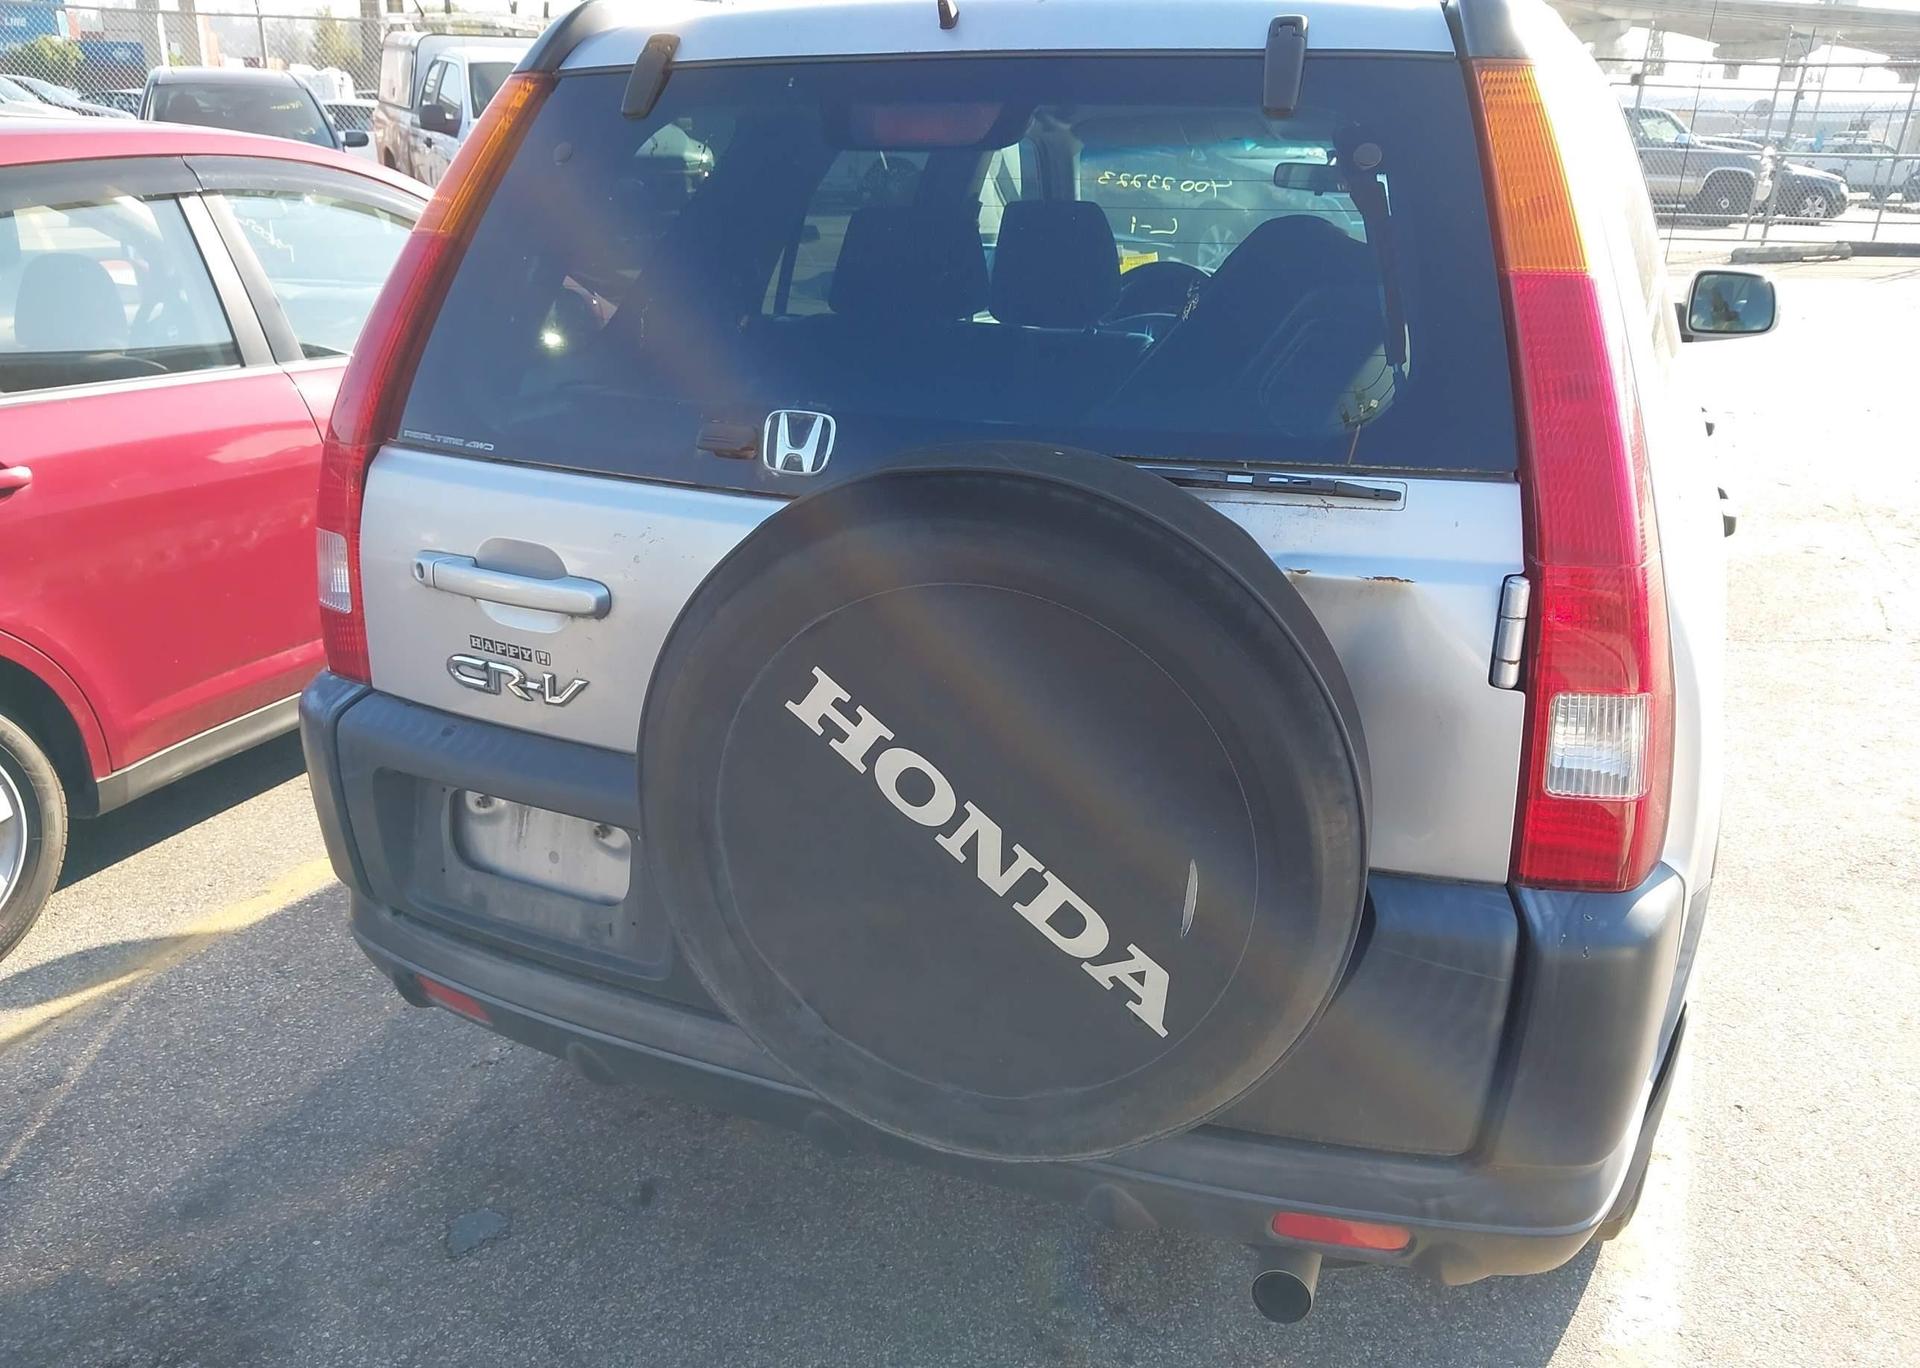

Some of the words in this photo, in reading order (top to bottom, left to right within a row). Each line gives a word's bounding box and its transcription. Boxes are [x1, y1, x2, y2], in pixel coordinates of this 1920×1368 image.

[470, 635, 533, 661] HAPPY
[447, 654, 590, 706] CR-V
[784, 666, 1169, 1038] HONDA
